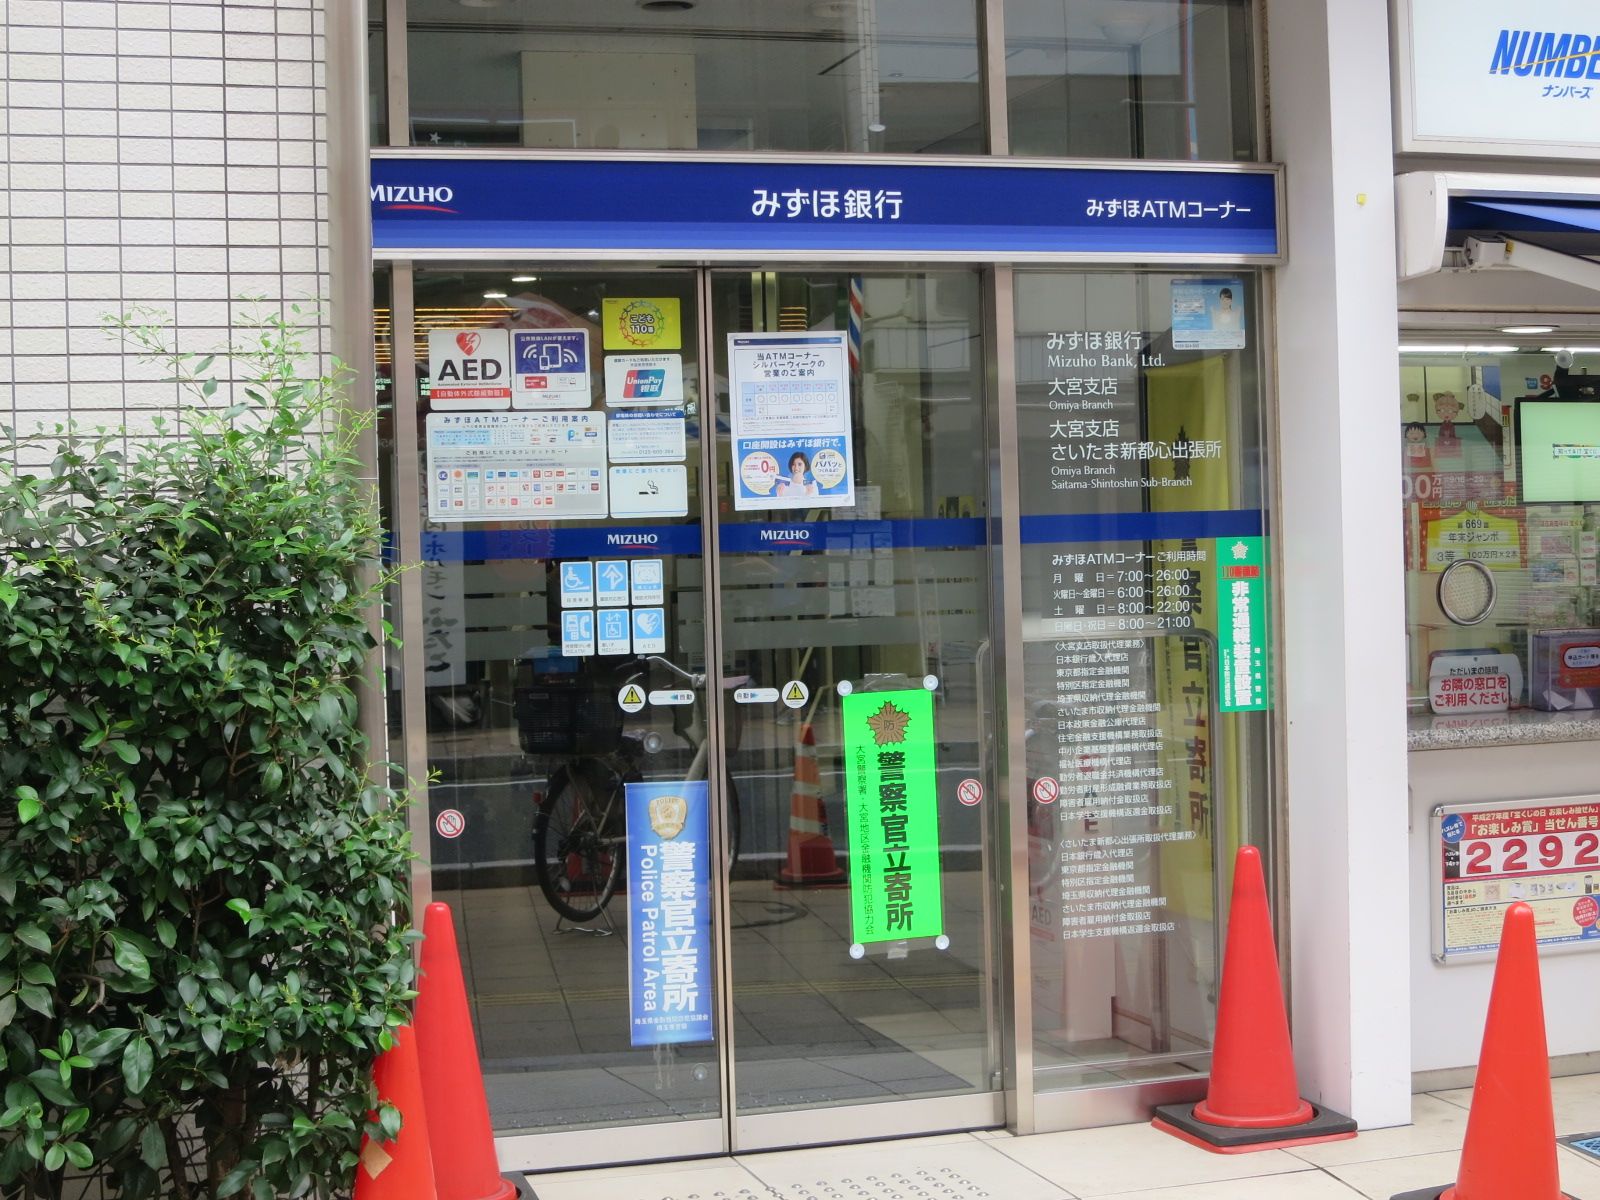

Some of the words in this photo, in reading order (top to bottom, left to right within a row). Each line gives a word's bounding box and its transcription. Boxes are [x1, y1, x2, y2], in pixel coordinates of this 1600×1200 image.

[1542, 85, 1593, 99] ナンバーズ
[369, 185, 453, 203] MIZUHO
[751, 187, 903, 220] みずほ銀行
[1086, 199, 1251, 219] みずほATMコーナー
[630, 314, 655, 323] こども
[1046, 331, 1142, 351] みずほ銀行
[757, 352, 820, 361] 当ATMコーナー
[1048, 355, 1097, 368] Mizuho
[1101, 354, 1138, 369] Bank,
[1141, 354, 1166, 367] Ltd.
[438, 358, 502, 381] AED
[753, 360, 825, 369] シルバーウィークの
[764, 368, 815, 377] 営業のご案内
[626, 376, 662, 387] UnionPay
[1048, 377, 1118, 396] 大宮支店
[1049, 400, 1080, 413] Omiya
[1082, 399, 1113, 410] Branch
[443, 415, 589, 424] みずほATMコーナーご利用案内
[1050, 419, 1120, 438] 大宮支店
[1051, 440, 1222, 461] さいたま新都心出張所
[1051, 466, 1082, 478] Omiya
[1084, 465, 1116, 475] Branch
[1051, 479, 1139, 490] Saitama-Shintoshin
[1141, 477, 1193, 488] Sub-Branch
[607, 534, 658, 545] MIZUHO
[760, 530, 810, 541] MIZUHO
[1448, 532, 1499, 543] 年末ジャンボ
[1052, 550, 1207, 566] みずほATMコーナーご利用時間
[1056, 665, 1130, 678] 東京都指定金融機関
[1450, 666, 1499, 676] ただいまの時間
[1441, 676, 1507, 691] お隣の窓口を
[1434, 691, 1508, 707] ご利用ください
[1057, 703, 1161, 717] さいたま市収納代理金融機関
[884, 718, 895, 732] 防
[1471, 821, 1540, 837] 「お楽しみ賞」
[1544, 816, 1599, 831] 当せん番号
[876, 751, 914, 932] 警察官立寄所
[1466, 833, 1599, 875] 2292
[640, 845, 657, 902] Police
[659, 841, 698, 1013] 警察官立寄所
[642, 907, 659, 963] Patrol
[643, 967, 657, 1011] Area
